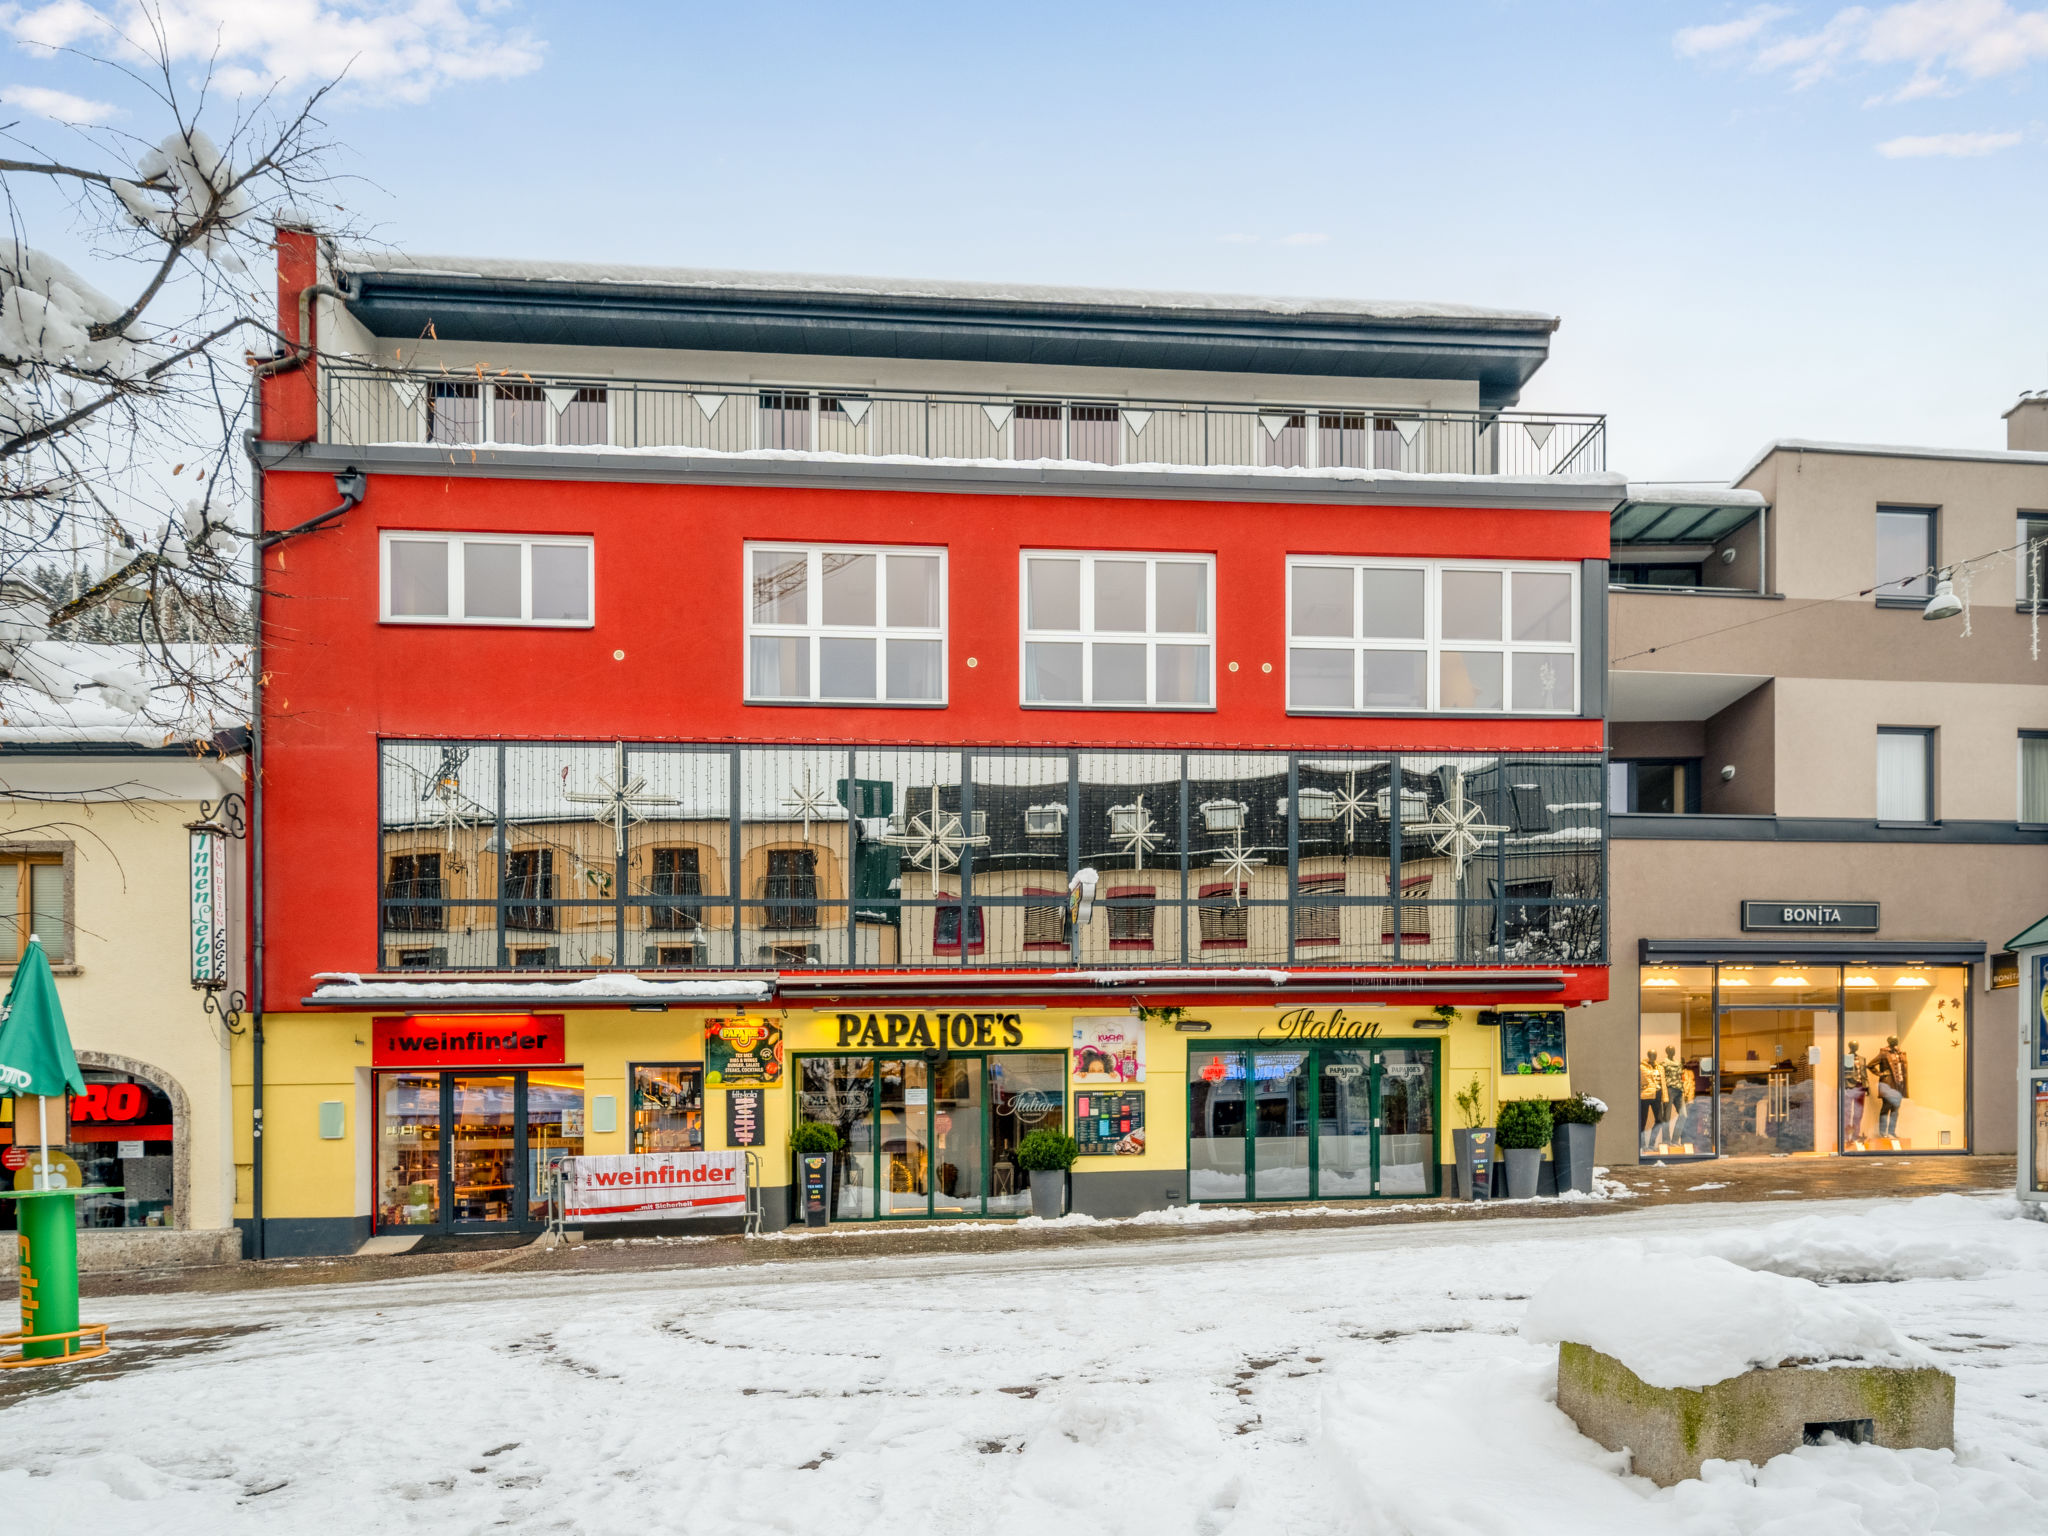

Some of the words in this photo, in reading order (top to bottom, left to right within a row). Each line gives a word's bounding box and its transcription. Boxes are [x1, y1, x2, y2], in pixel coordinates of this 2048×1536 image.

[1258, 1007, 1383, 1047] Italian
[398, 1031, 548, 1051] weinfinder
[71, 1083, 145, 1122] RO
[594, 1164, 735, 1187] weinfinder
[655, 1201, 693, 1210] Sicherheit
